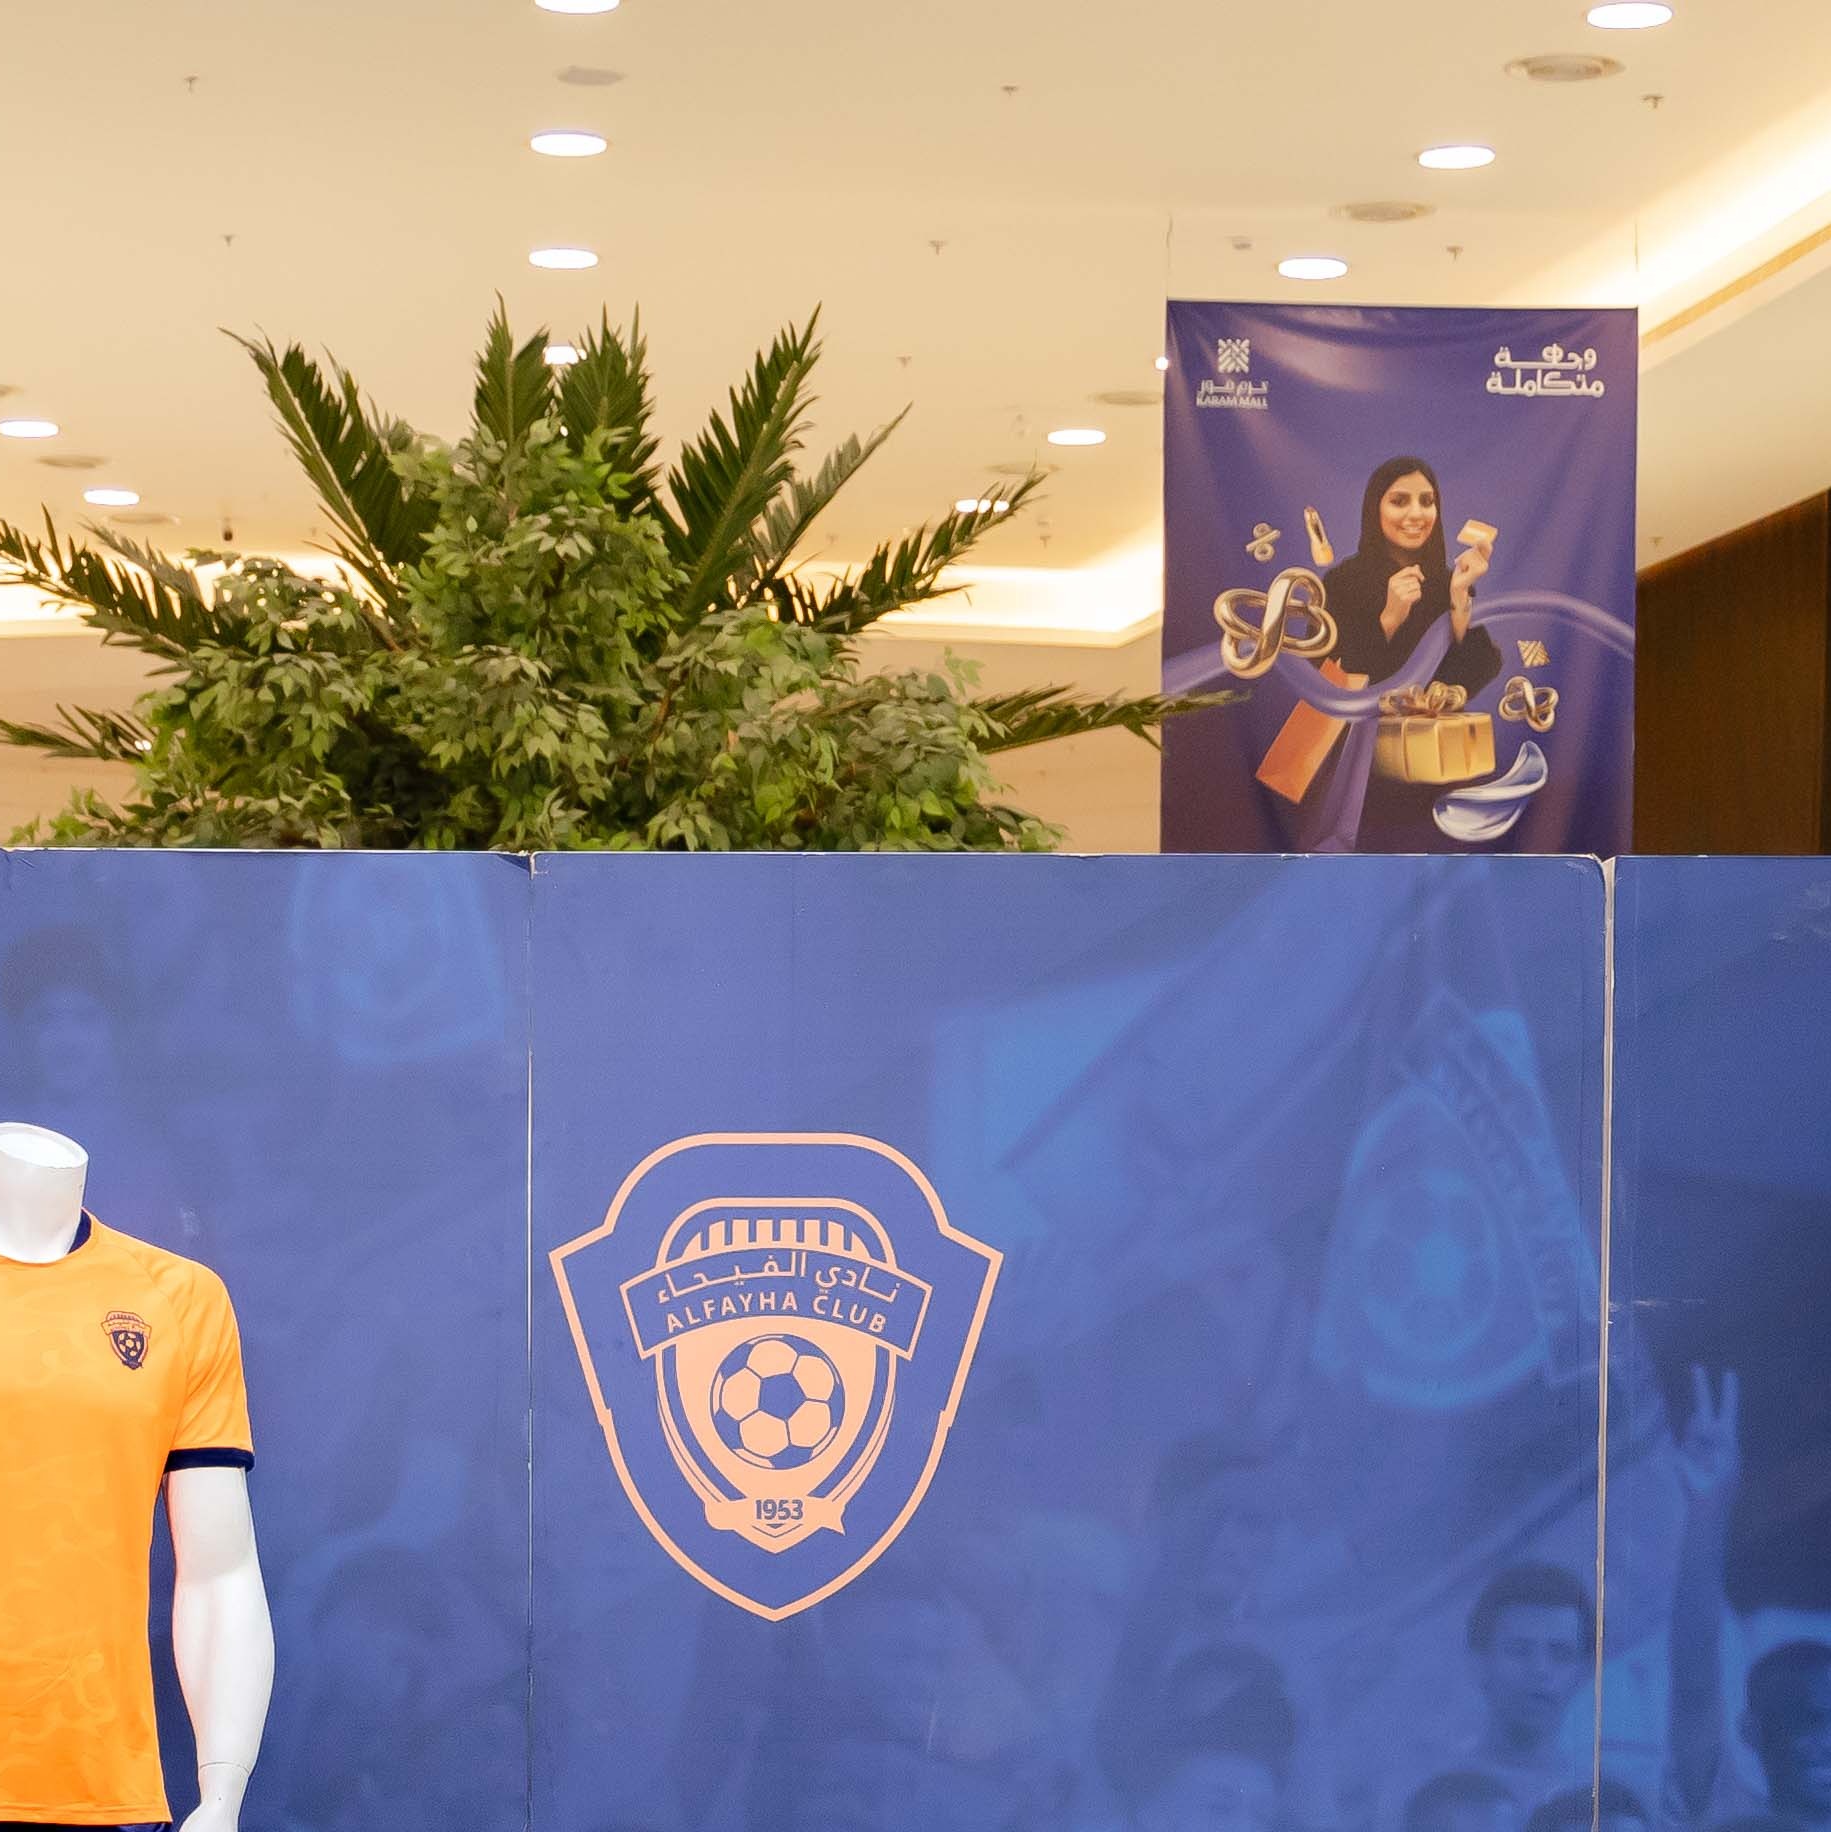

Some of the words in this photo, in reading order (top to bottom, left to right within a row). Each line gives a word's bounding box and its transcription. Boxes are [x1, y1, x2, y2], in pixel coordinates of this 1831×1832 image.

[1494, 343, 1598, 370] وجهة
[1486, 369, 1605, 398] متكاملة
[658, 1251, 808, 1304] الفيحاء
[815, 1263, 901, 1305] نادي
[665, 1290, 799, 1335] ALFAYHA
[812, 1293, 888, 1335] CLUB
[754, 1498, 805, 1521] 1953
